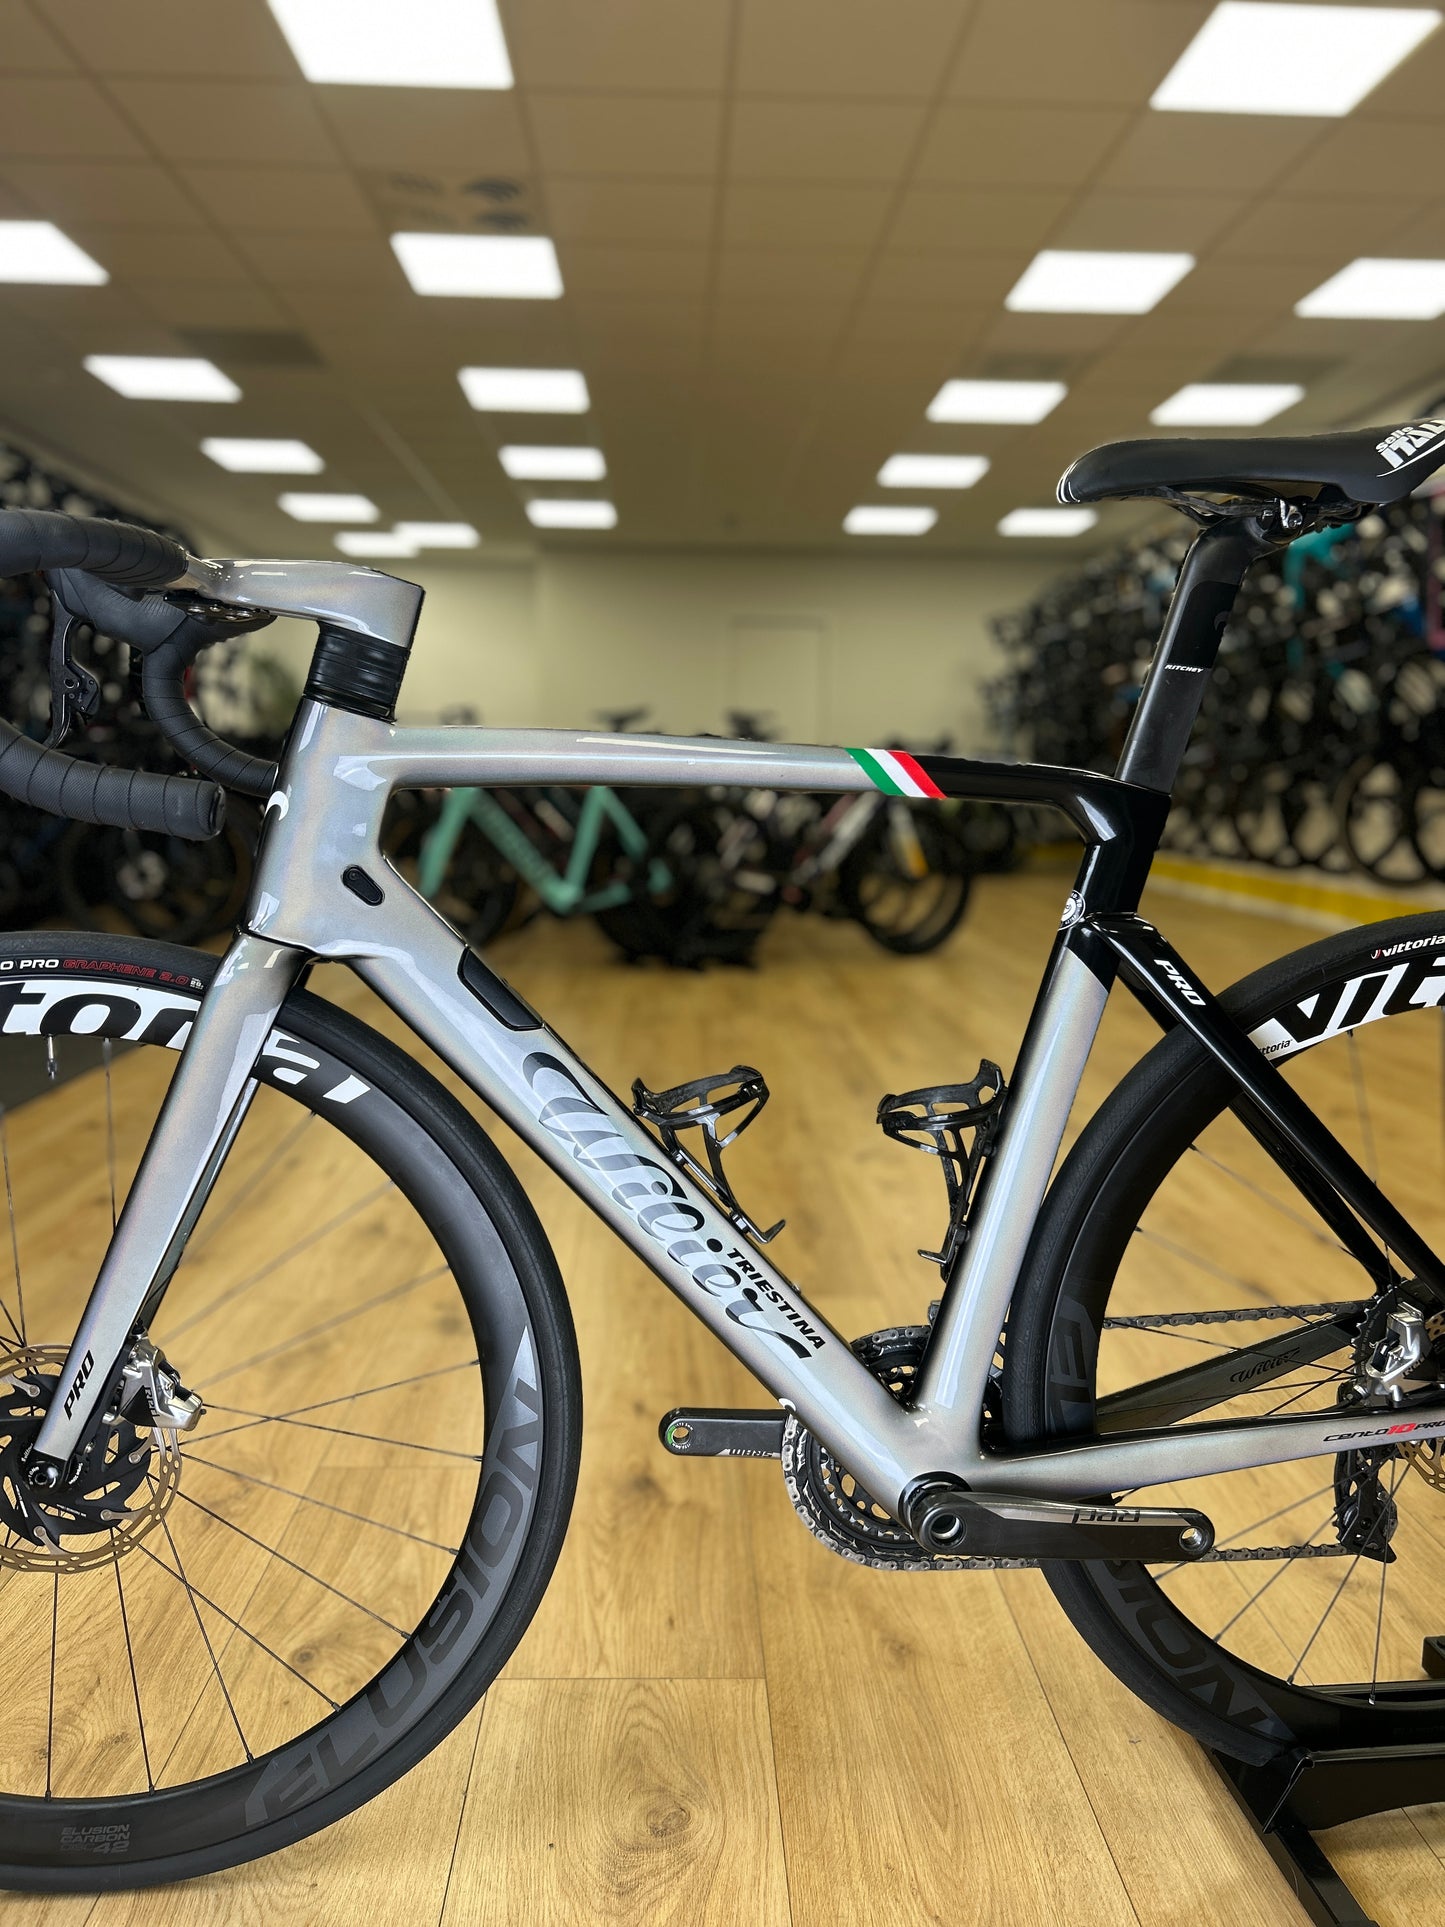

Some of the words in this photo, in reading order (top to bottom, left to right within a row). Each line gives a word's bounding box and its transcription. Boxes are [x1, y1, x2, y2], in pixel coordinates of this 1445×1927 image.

[1164, 664, 1204, 673] RITCHEY
[20, 959, 59, 969] PRO
[62, 958, 156, 979] GRAPHENE
[158, 971, 190, 986] 2.0
[1153, 959, 1206, 1006] PRO
[726, 1247, 826, 1351] TRIESTINA
[63, 1349, 95, 1421] PRO
[60, 1832, 131, 1843] CARBON
[61, 1824, 130, 1836] ELUSION
[93, 1840, 130, 1854] 42
